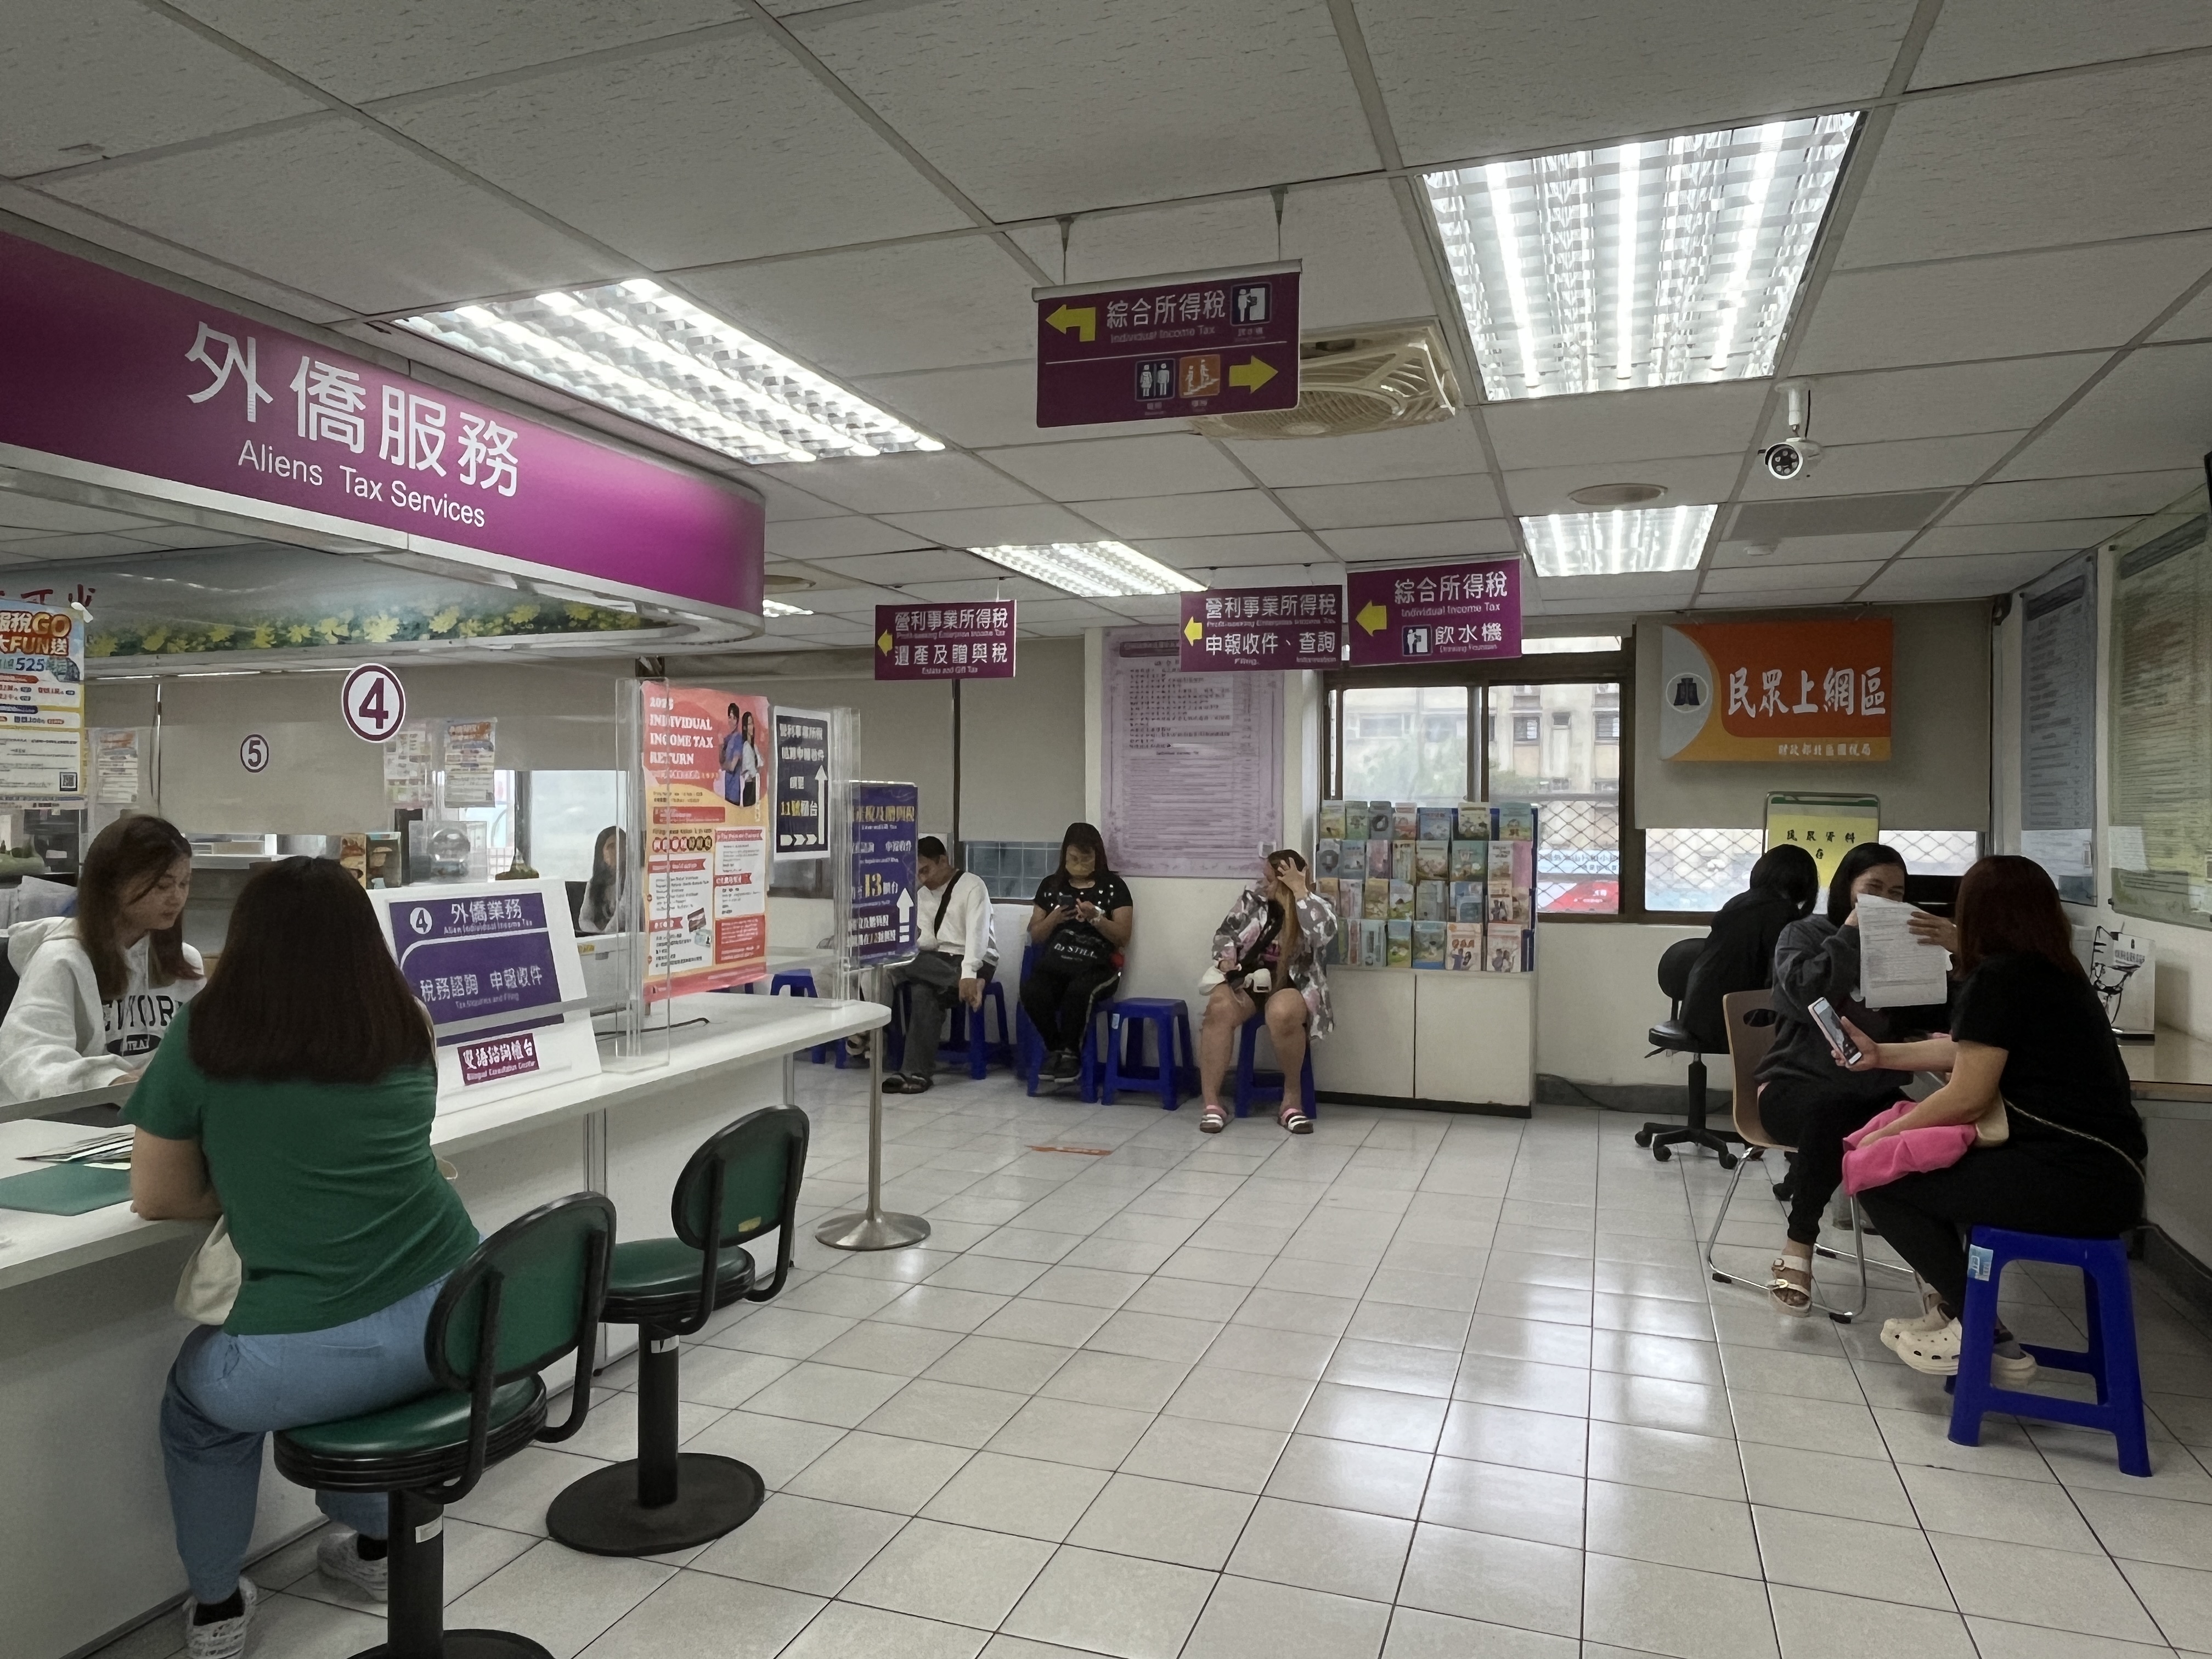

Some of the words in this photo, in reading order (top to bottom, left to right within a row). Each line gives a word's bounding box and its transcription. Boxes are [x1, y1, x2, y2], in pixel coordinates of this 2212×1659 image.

[1107, 290, 1226, 329] 綜合所得稅
[1197, 325, 1215, 335] Tax
[184, 320, 518, 496] 外僑服務
[238, 439, 323, 486] Aliens
[339, 464, 383, 502] Tax
[390, 480, 485, 527] Services
[1394, 571, 1508, 604] 綜合所得稅
[1205, 594, 1336, 619] 營利事業所得稅
[1483, 602, 1500, 611] Tax
[895, 608, 1008, 631] 營利事業所得稅
[1205, 631, 1335, 656] 申報收件、查詢
[1435, 622, 1502, 645] 飲水機
[895, 642, 1007, 665] 遺產及贈與稅
[359, 677, 389, 730] 4
[1728, 667, 1886, 718] 民眾上網區
[248, 740, 262, 768] 5
[692, 735, 714, 748] TAX
[416, 909, 428, 933] 4
[451, 898, 522, 924] 外僑業務
